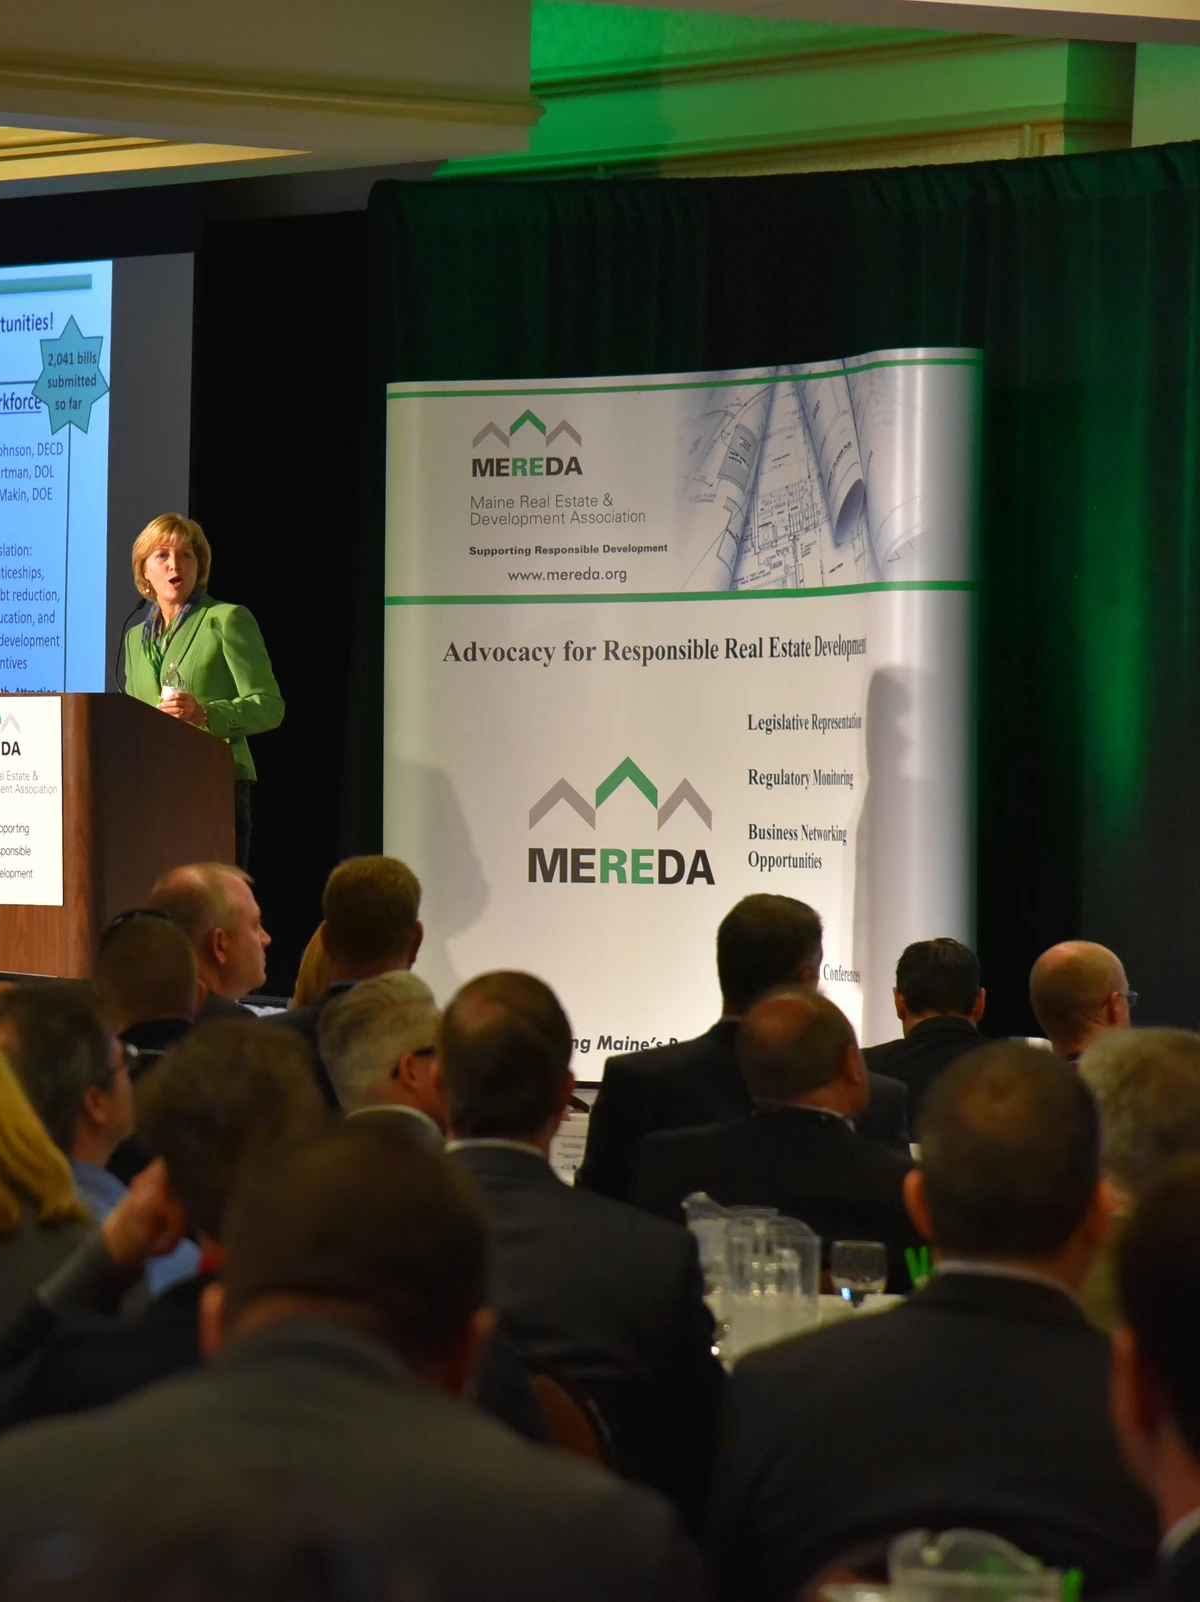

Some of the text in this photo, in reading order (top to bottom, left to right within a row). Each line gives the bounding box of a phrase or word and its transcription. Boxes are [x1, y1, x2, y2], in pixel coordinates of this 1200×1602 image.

[48, 351, 97, 367] 2,041 bills
[47, 373, 97, 389] submitted
[55, 397, 82, 410] so far
[37, 442, 64, 456] DECD
[34, 465, 54, 478] DOL
[472, 456, 583, 478] MEREDA
[32, 487, 53, 501] DOE
[470, 493, 613, 509] Maine Real Estate &
[470, 509, 646, 528] Development Association
[469, 544, 668, 557] Supporting Responsible Development
[508, 567, 627, 583] www.mereda.org
[12, 588, 60, 603] reduction,
[37, 610, 55, 624] and
[442, 641, 556, 668] Advocacy
[563, 640, 597, 662] for
[603, 638, 719, 667] Responsible
[724, 637, 763, 659] Real
[768, 636, 811, 659] Estate
[747, 712, 861, 735] Legislative Representation
[7, 770, 30, 781] Estate
[32, 770, 39, 781] &
[748, 768, 853, 790] Regulatory Monitoring
[15, 784, 58, 795] Association
[748, 823, 847, 846] Business Networking
[528, 847, 715, 885] MEREDA
[748, 850, 822, 872] Opportunities
